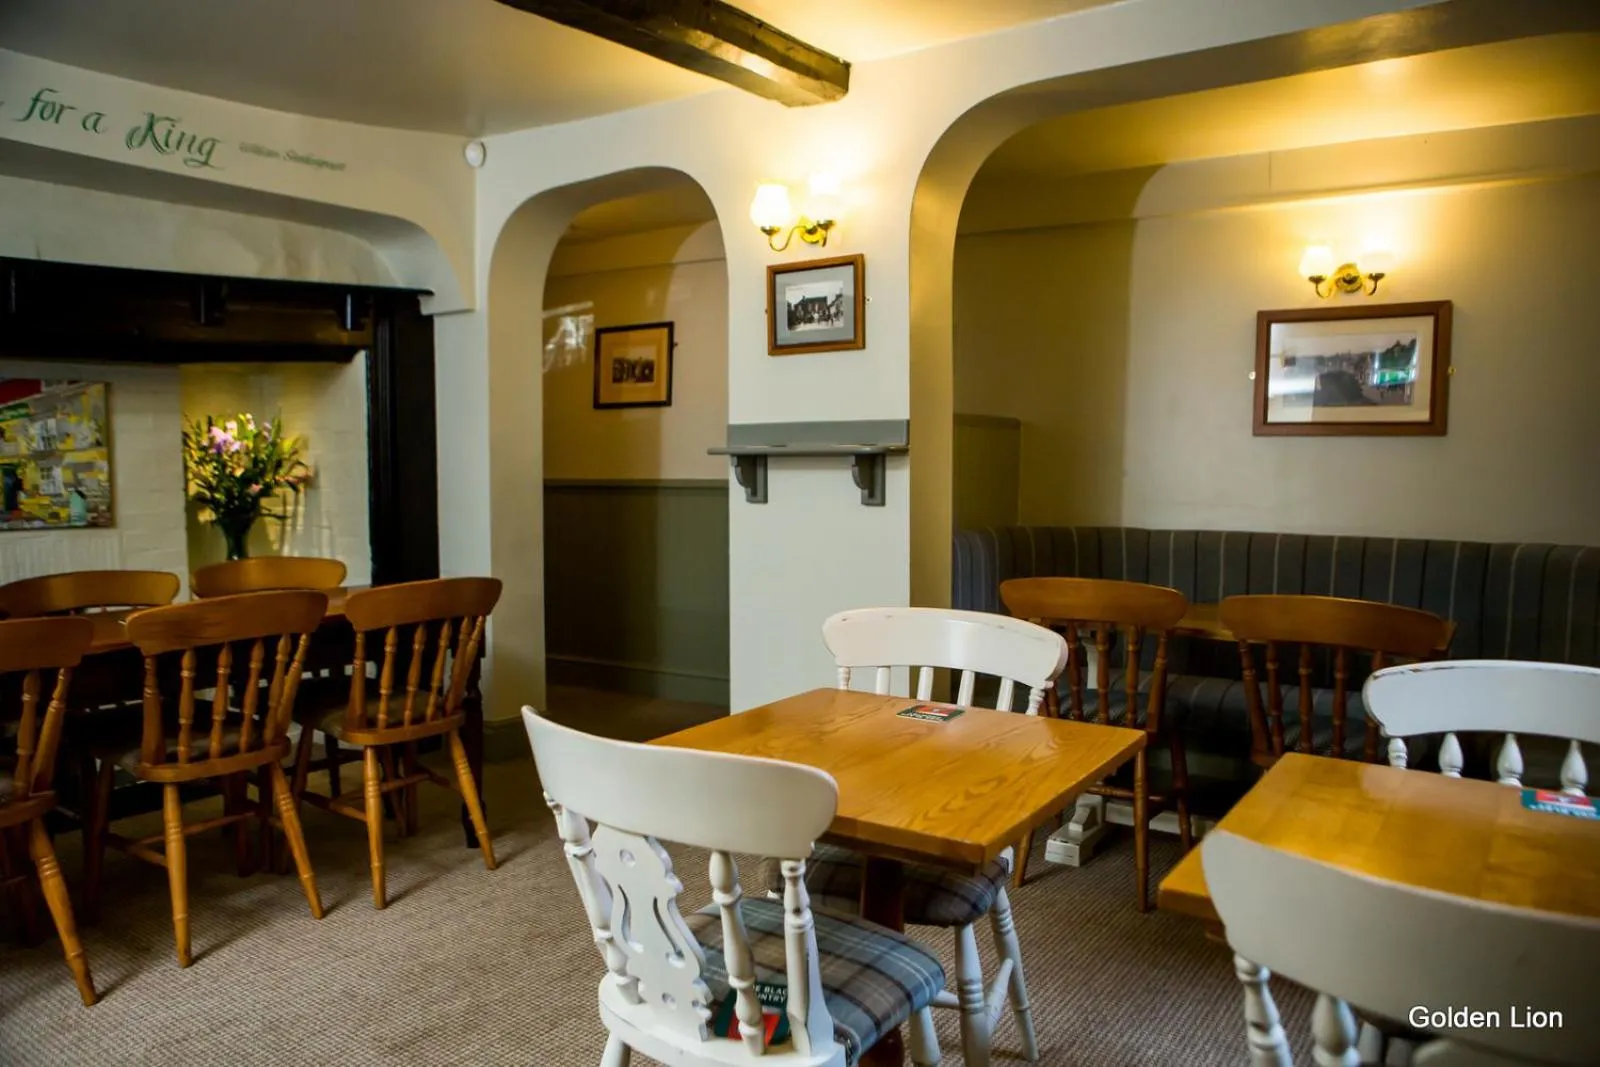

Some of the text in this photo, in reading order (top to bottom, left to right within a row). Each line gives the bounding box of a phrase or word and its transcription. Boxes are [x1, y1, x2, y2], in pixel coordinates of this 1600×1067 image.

[11, 87, 77, 124] for
[81, 111, 107, 134] a
[125, 111, 224, 170] King
[764, 985, 787, 995] BLAC
